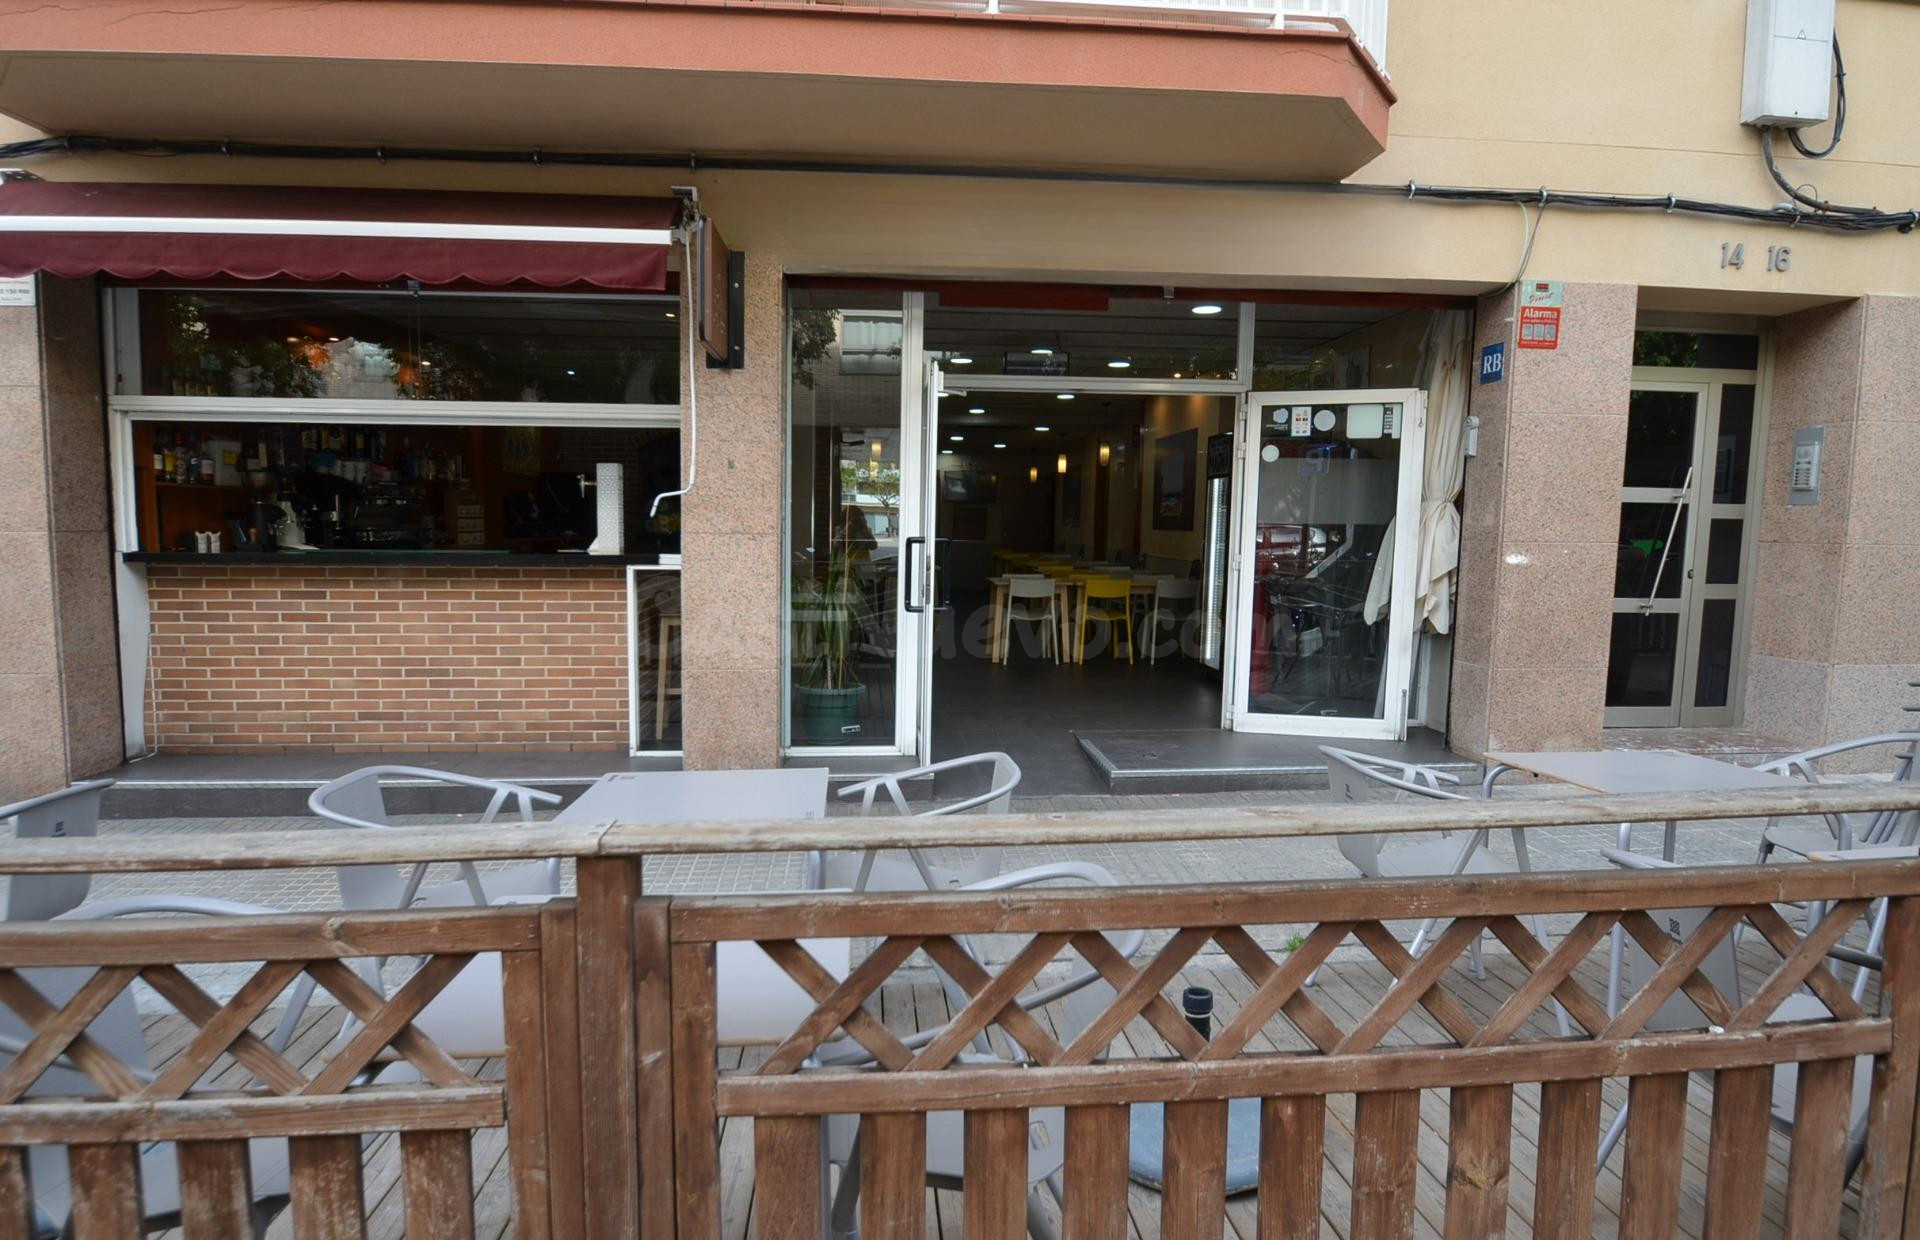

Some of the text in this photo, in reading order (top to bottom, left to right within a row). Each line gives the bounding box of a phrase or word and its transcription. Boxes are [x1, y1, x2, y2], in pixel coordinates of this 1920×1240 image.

[1721, 242, 1792, 272] 14 16
[1523, 308, 1557, 318] Alarma
[1483, 353, 1502, 374] RB
